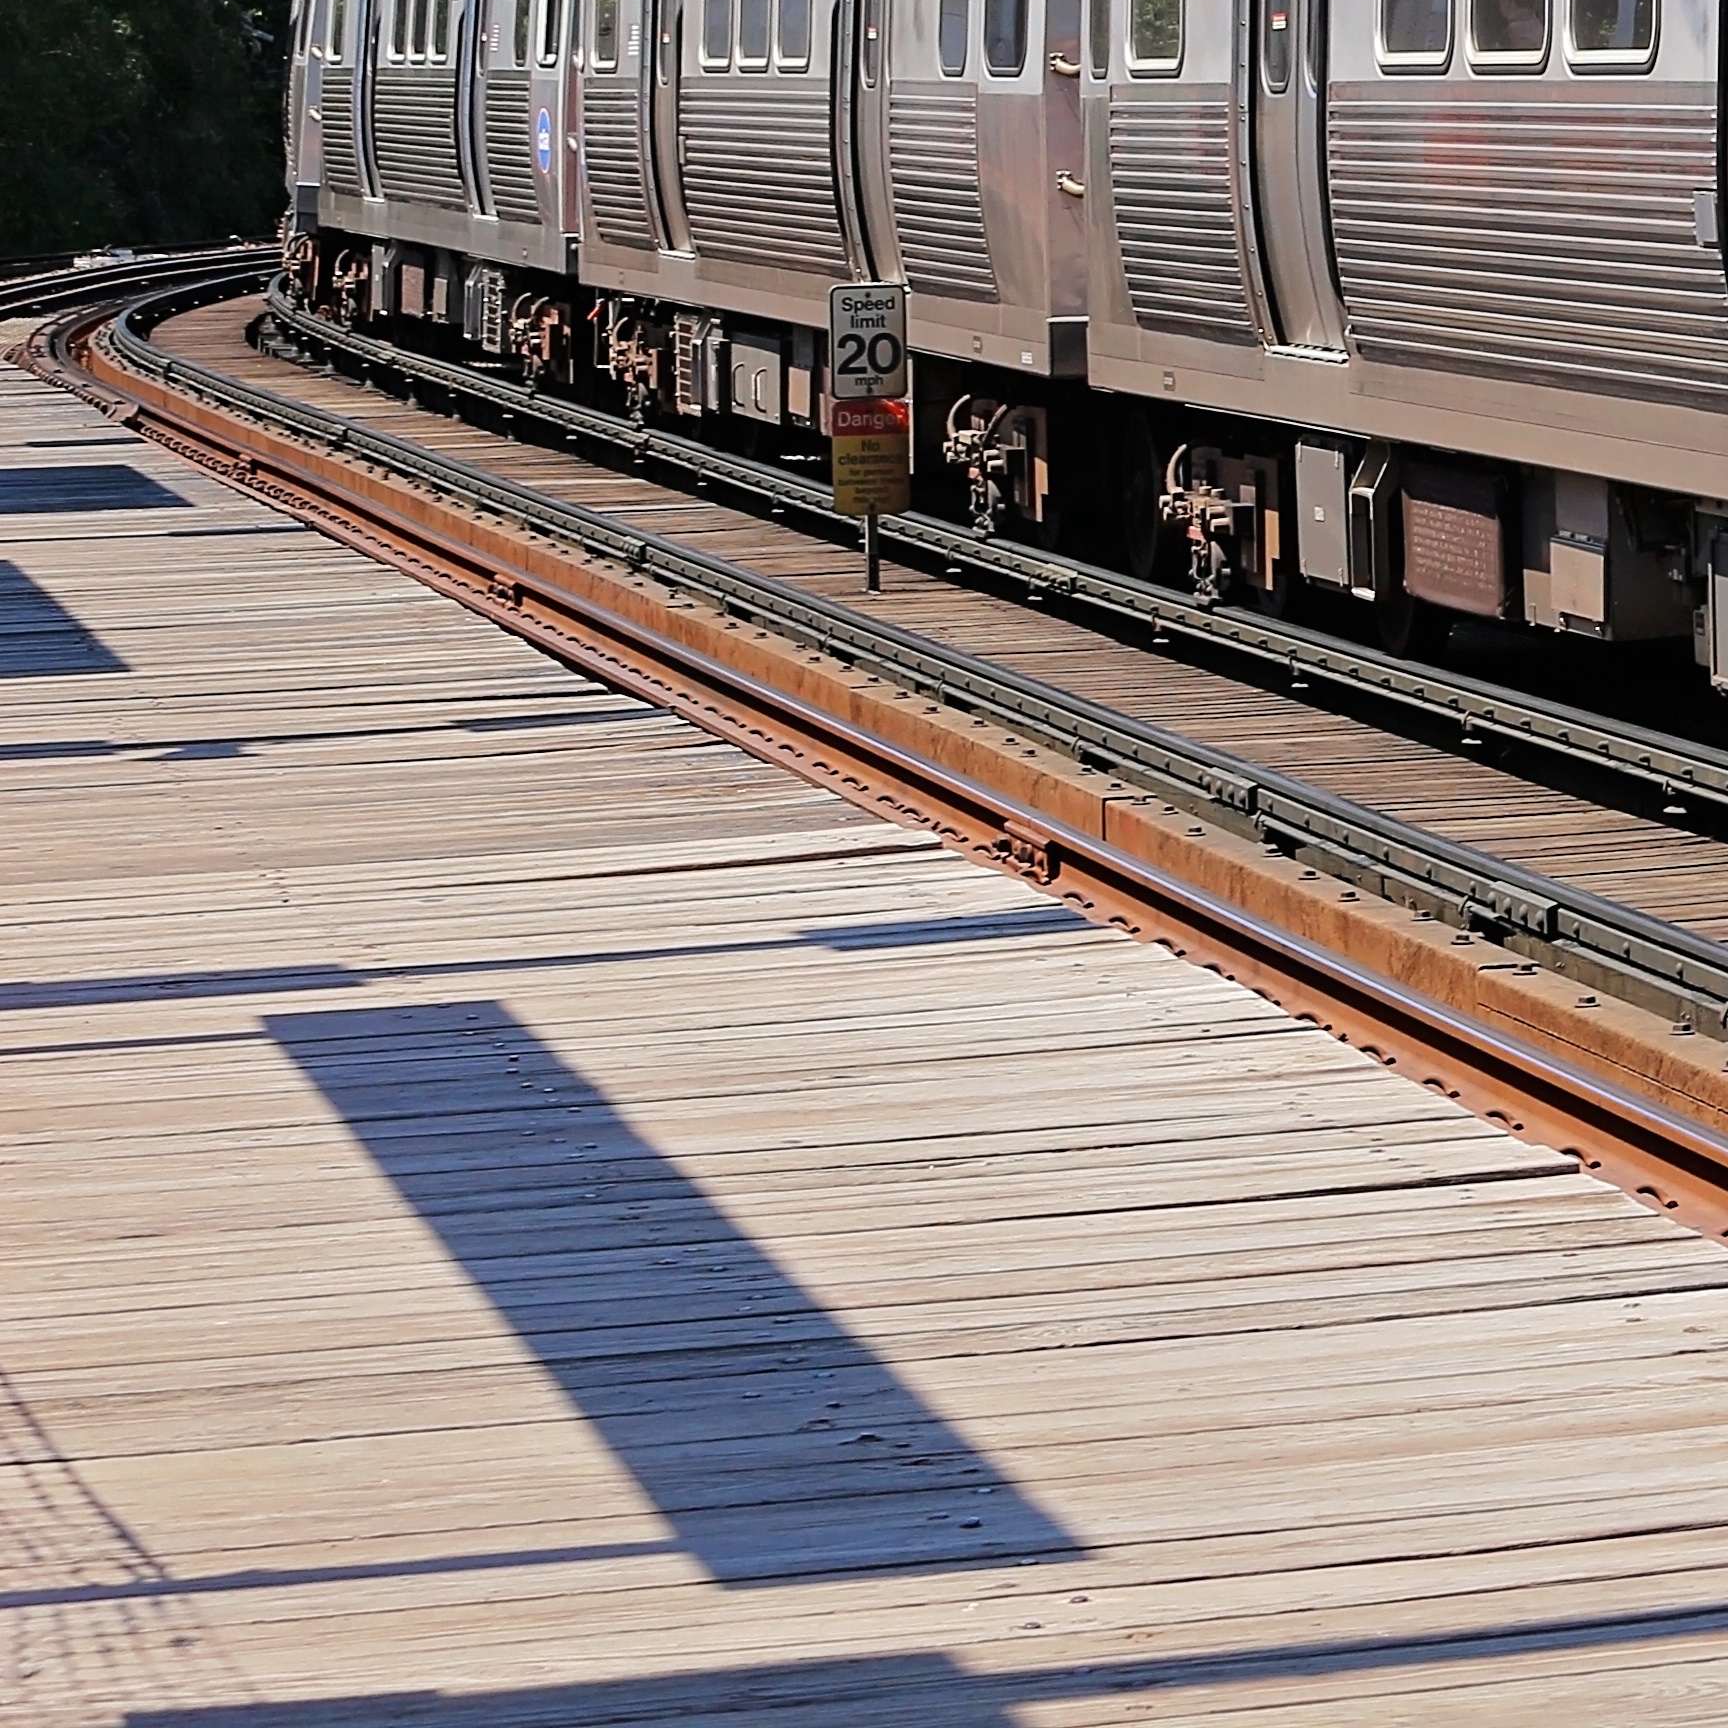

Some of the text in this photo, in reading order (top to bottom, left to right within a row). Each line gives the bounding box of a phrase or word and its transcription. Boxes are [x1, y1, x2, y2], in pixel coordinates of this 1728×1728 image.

[841, 296, 896, 314] Speed
[850, 314, 886, 329] limit
[837, 332, 902, 375] 20
[855, 375, 884, 386] mph
[837, 411, 904, 429] Danger
[861, 439, 880, 452] No
